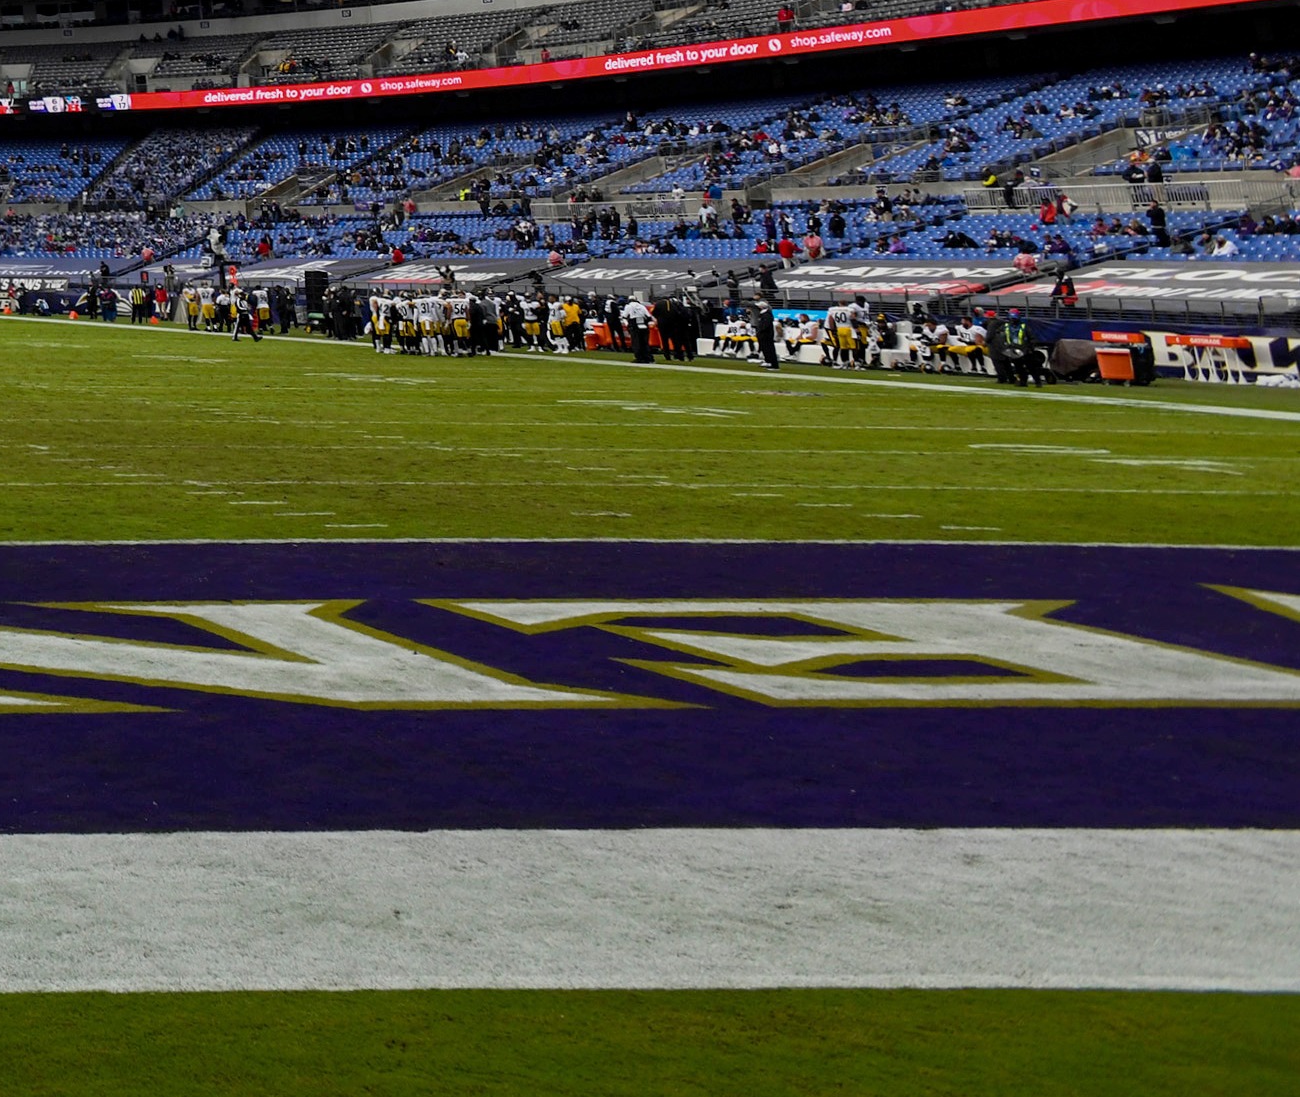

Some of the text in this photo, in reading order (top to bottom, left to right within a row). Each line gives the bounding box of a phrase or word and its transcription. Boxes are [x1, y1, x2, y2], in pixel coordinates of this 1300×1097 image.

[604, 24, 892, 72] delivered fresh to your door shop.safeway.com
[204, 75, 462, 103] delivered fresh to your door shop.safeway.com
[785, 265, 1018, 278] RAVENS
[834, 311, 847, 324] 60
